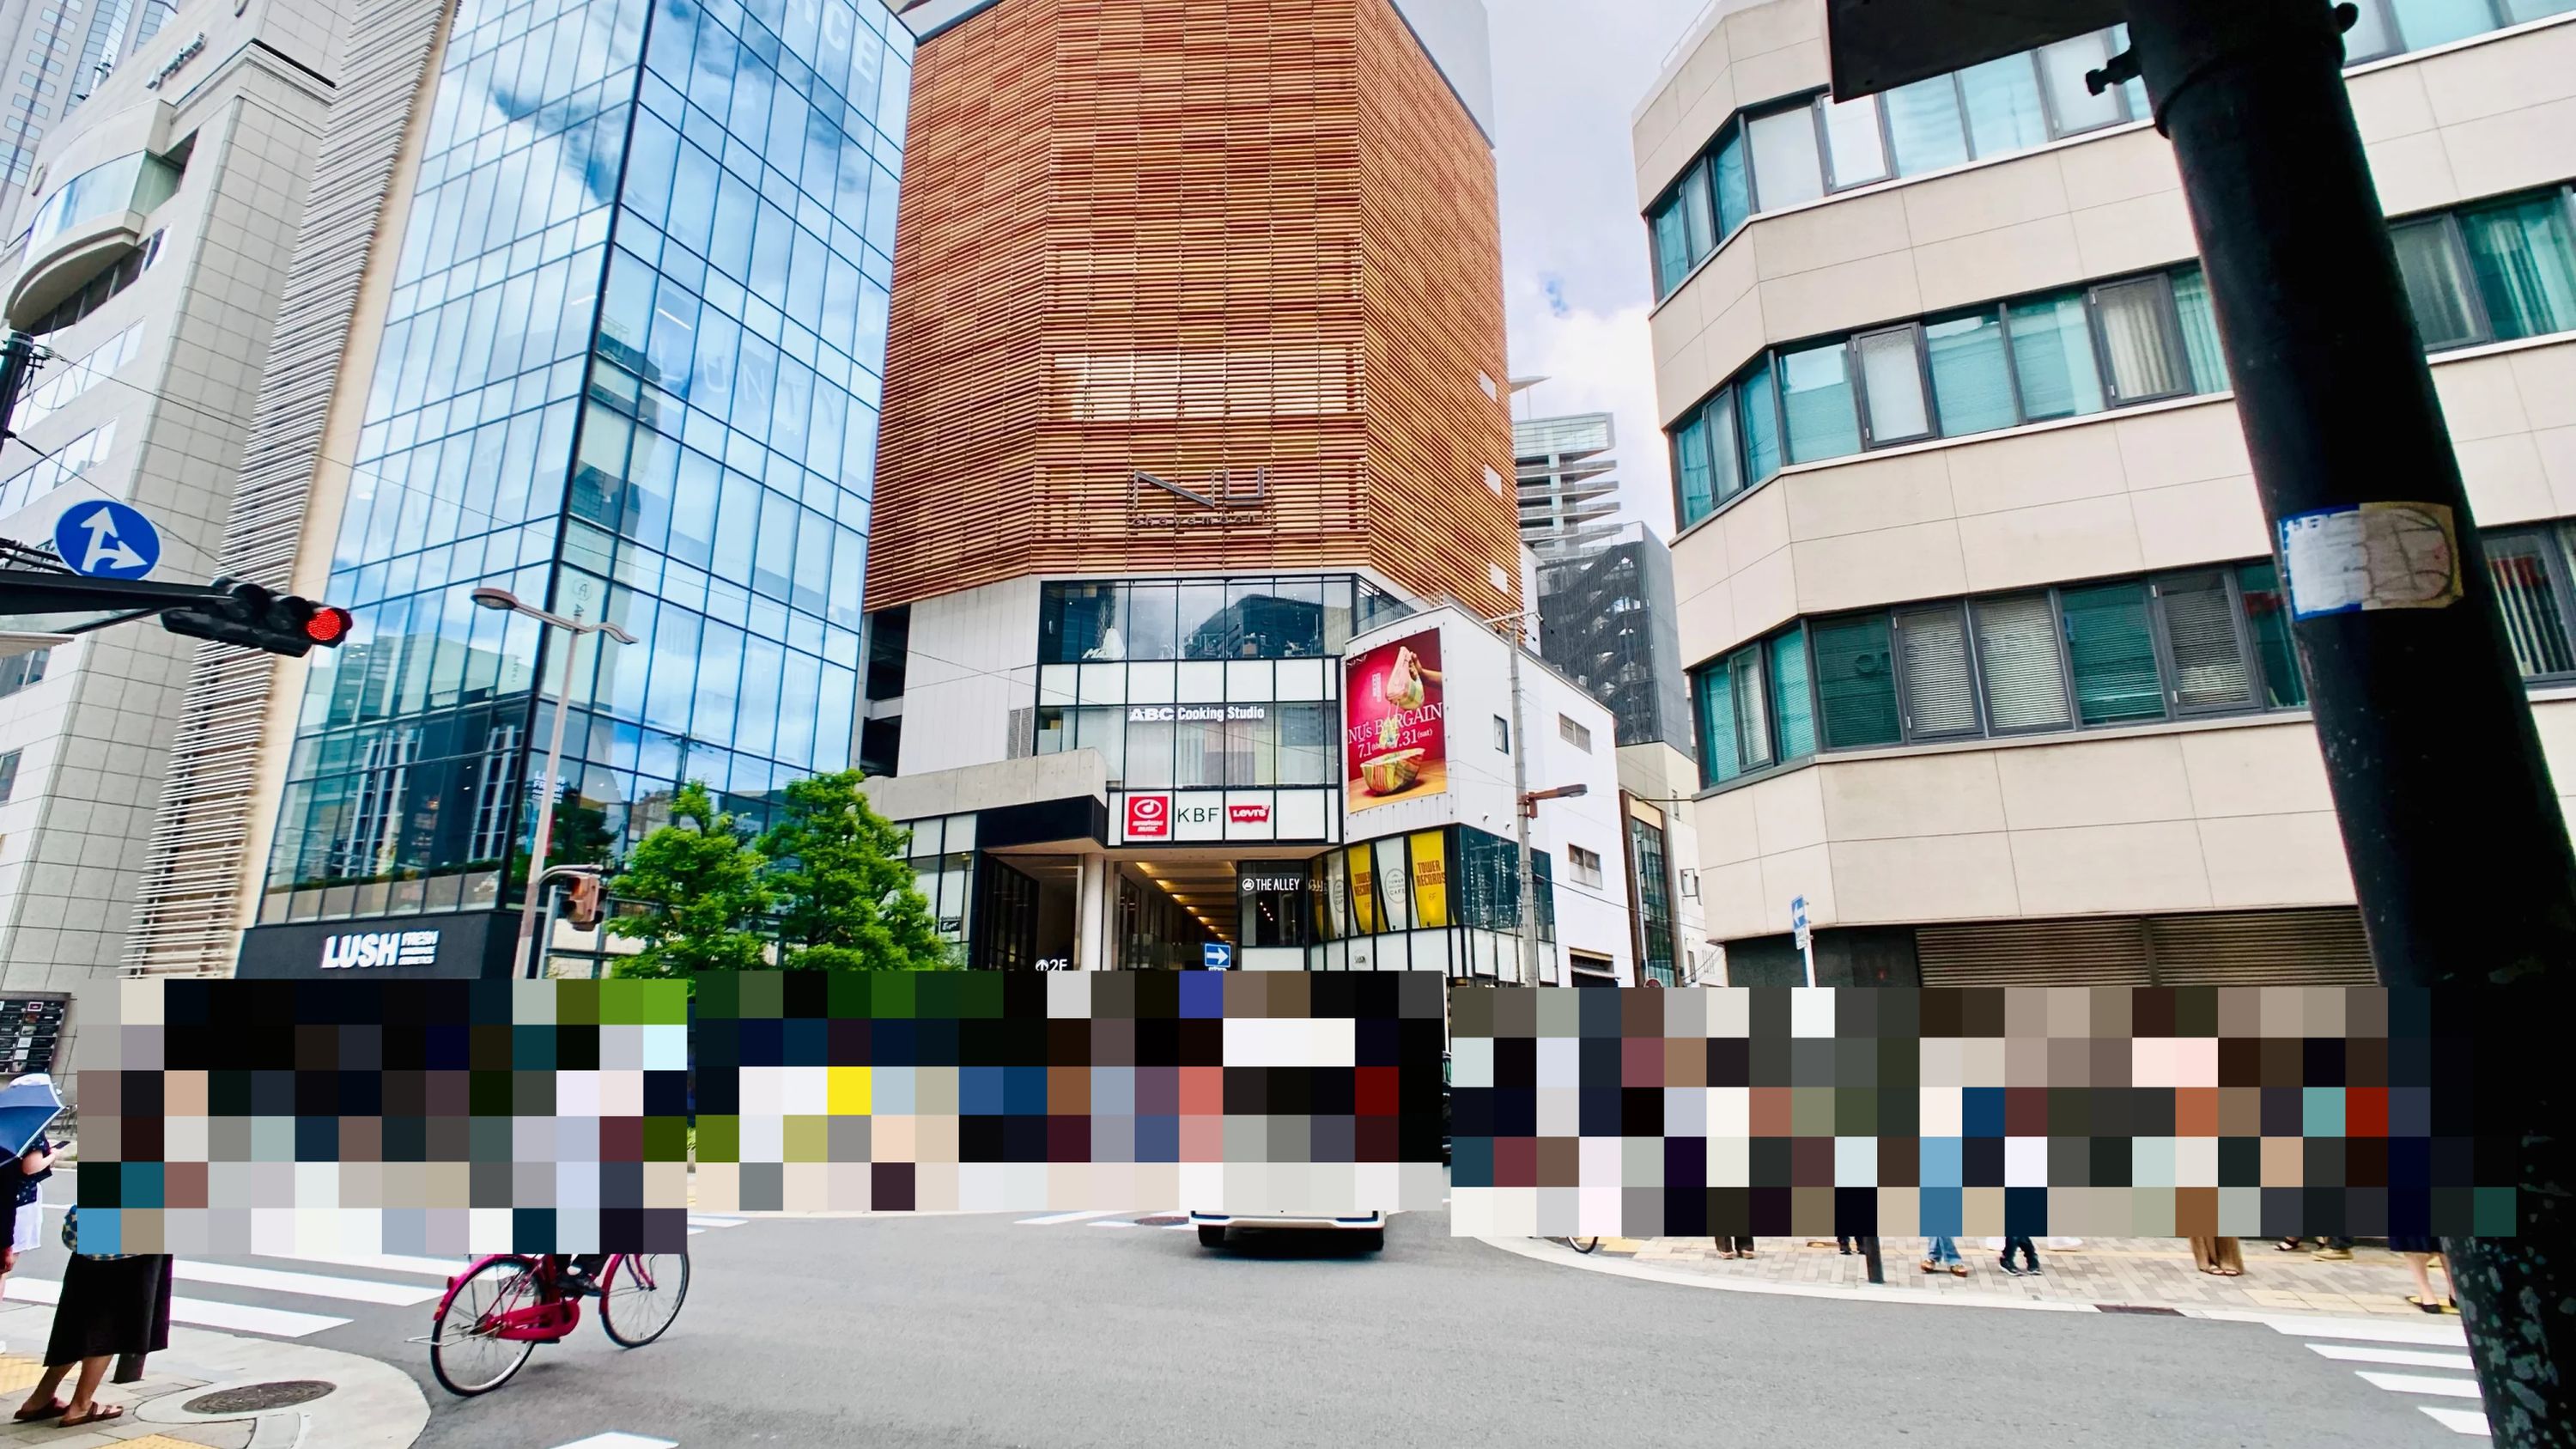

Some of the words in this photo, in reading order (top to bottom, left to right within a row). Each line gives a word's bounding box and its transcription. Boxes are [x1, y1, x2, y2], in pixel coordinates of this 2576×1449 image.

[1133, 466, 1265, 508] NU
[1129, 707, 1175, 721] ABC
[1177, 707, 1224, 722] Cooking
[1227, 705, 1265, 720] Studio
[1374, 702, 1443, 736] BRGAIN
[1177, 807, 1219, 823] KBF
[1417, 860, 1441, 874] TOWER
[1255, 878, 1272, 891] THE
[1273, 878, 1300, 891] ALLEY
[1416, 872, 1446, 887] RECORDS
[321, 932, 400, 968] LUSH
